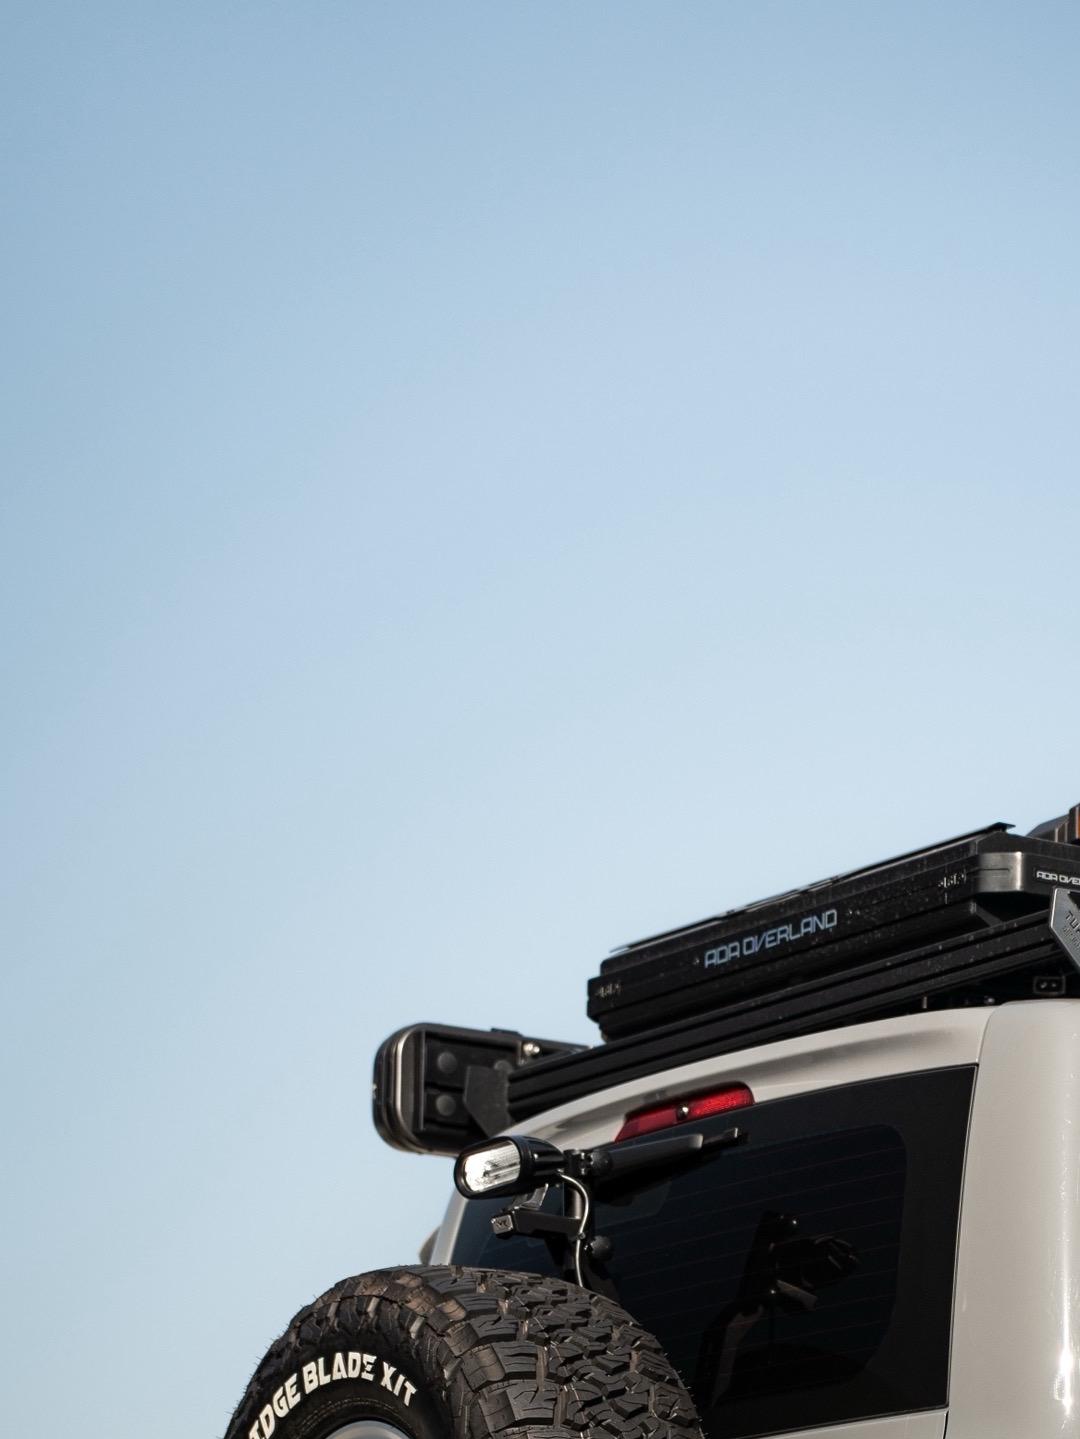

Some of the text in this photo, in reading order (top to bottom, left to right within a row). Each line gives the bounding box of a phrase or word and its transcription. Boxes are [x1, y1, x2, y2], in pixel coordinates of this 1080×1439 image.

[1036, 870, 1058, 882] ADA
[704, 909, 837, 968] ADA OVERLAND
[302, 1352, 377, 1395] BLADE
